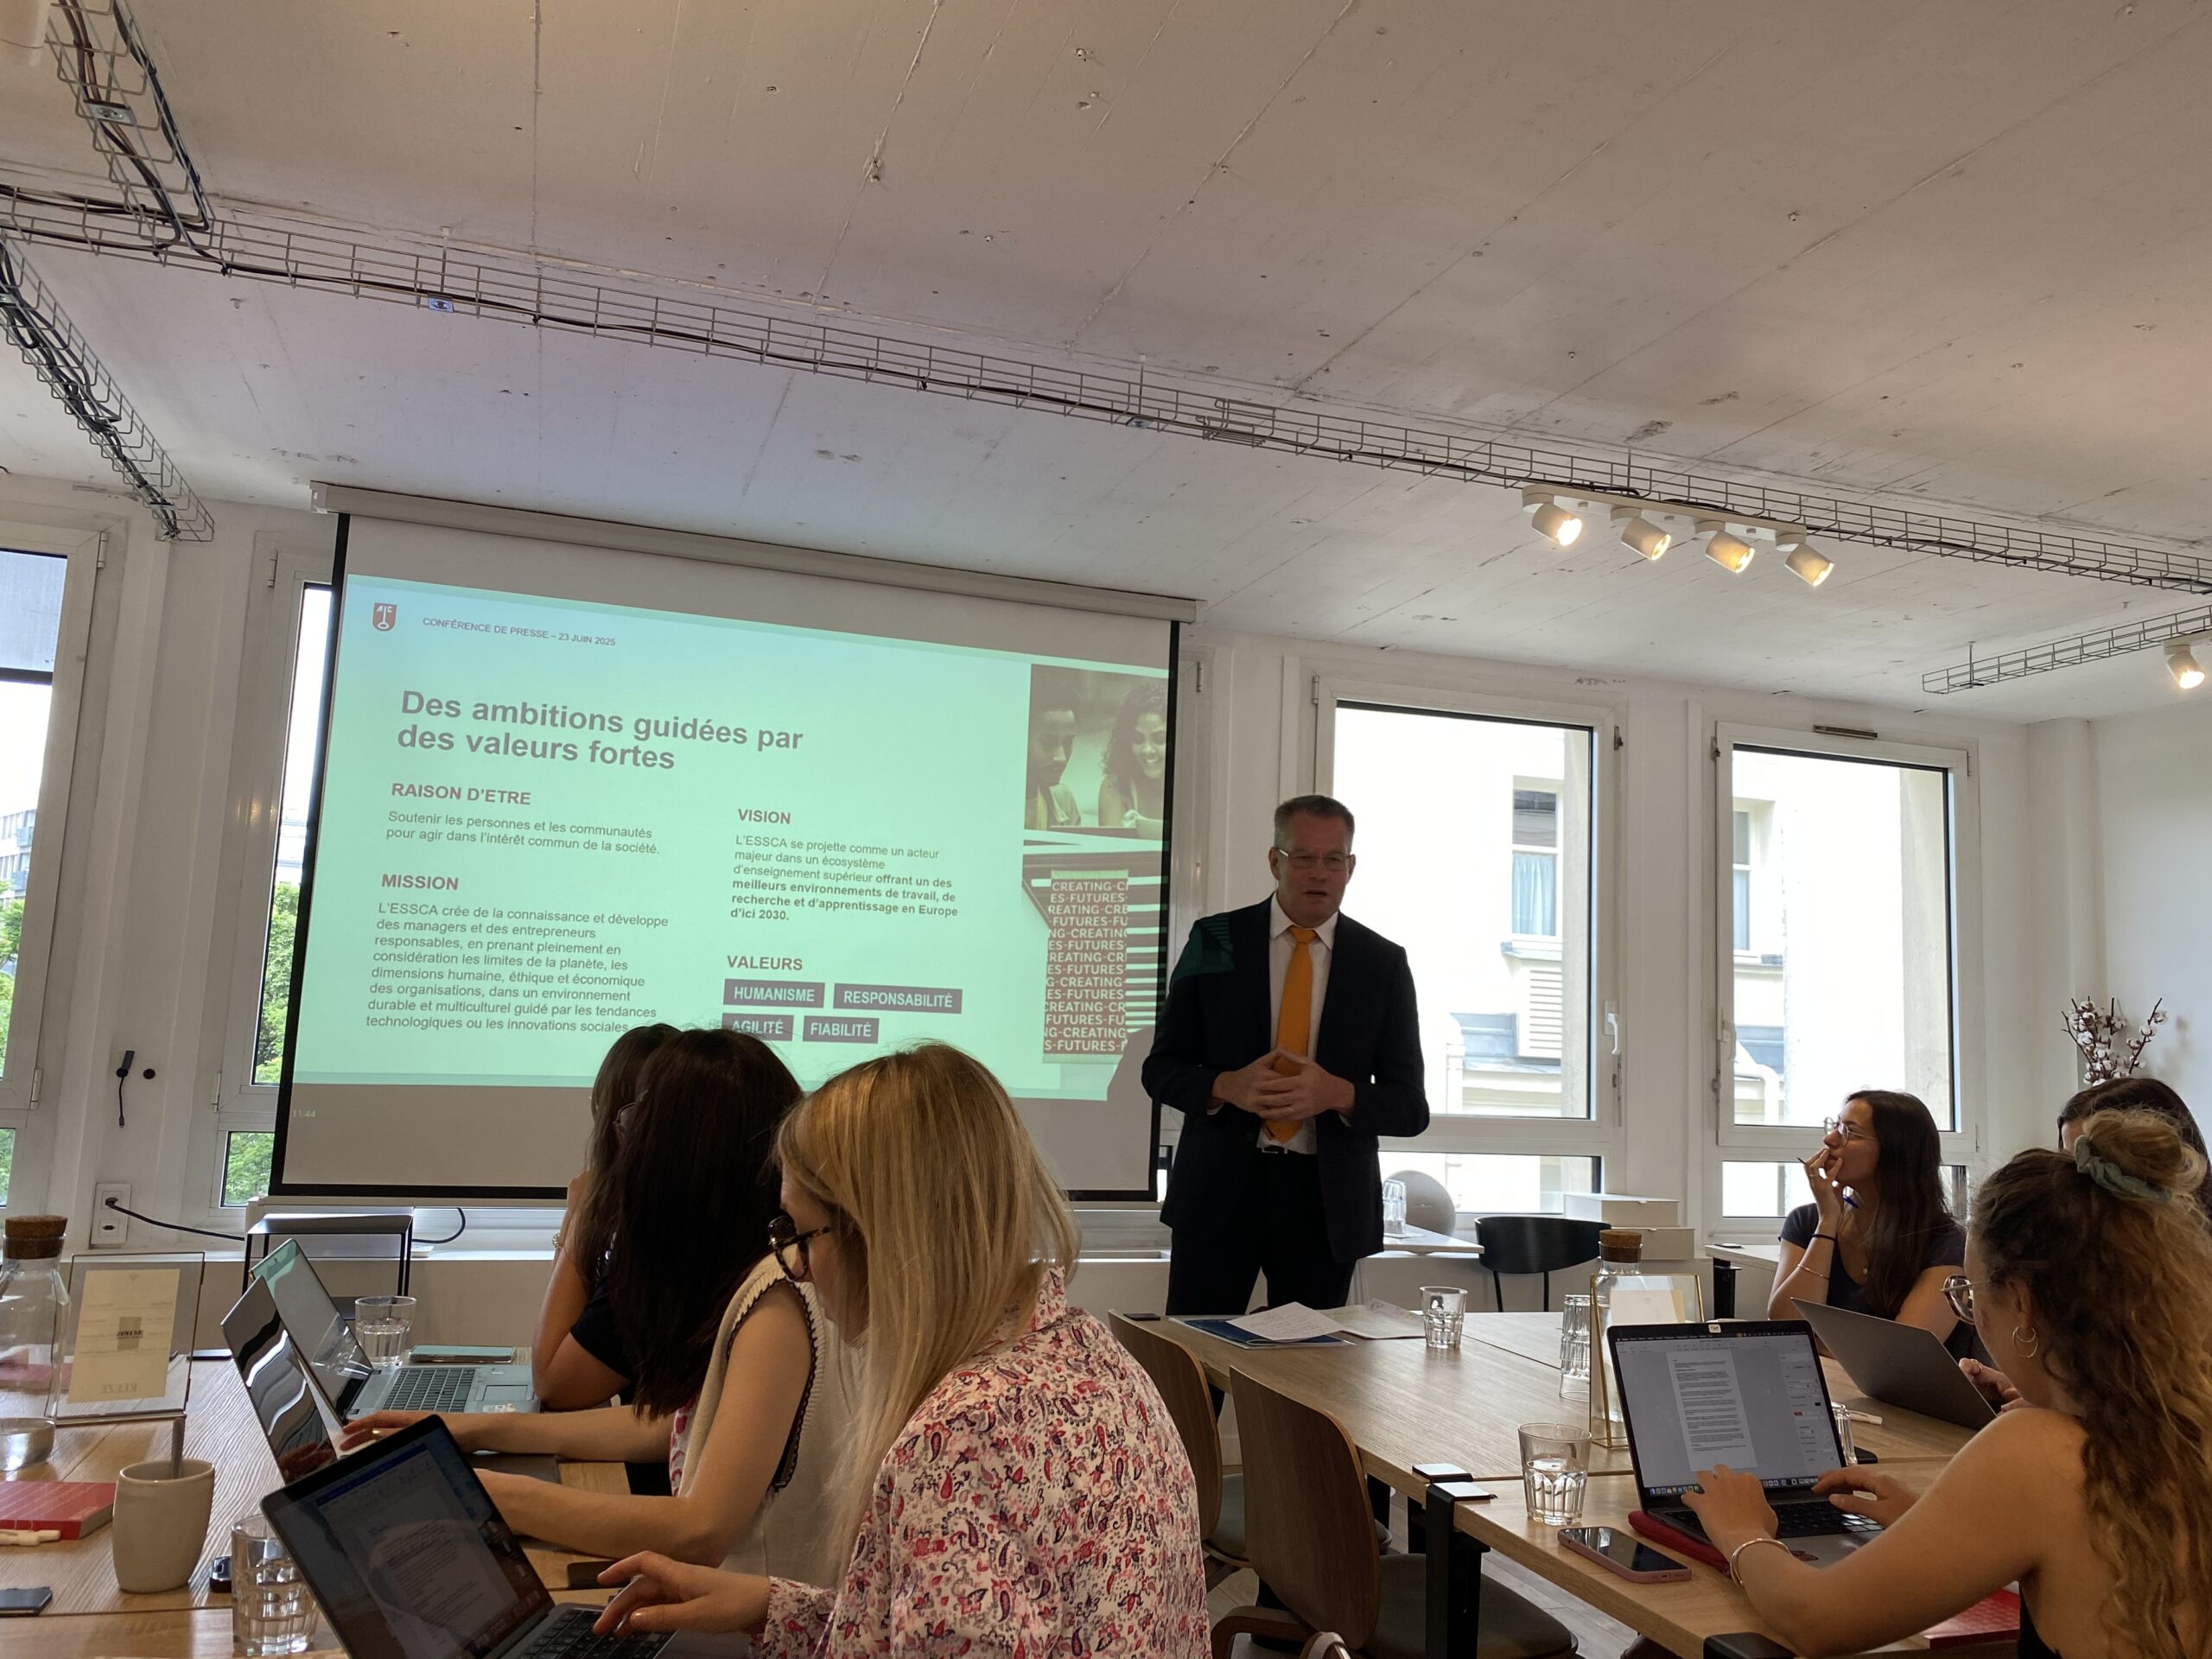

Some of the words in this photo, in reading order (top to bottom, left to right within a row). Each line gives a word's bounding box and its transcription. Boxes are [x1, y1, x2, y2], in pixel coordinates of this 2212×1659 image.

[423, 618, 492, 632] CONFÉRENCE
[493, 625, 507, 634] DE
[510, 626, 549, 639] PRESSE
[558, 632, 569, 641] 23
[570, 634, 593, 644] JUIN
[594, 637, 616, 646] 2025
[402, 690, 461, 718] Des
[472, 702, 623, 733] ambitions
[633, 716, 747, 745] guidées
[758, 729, 804, 750] par
[397, 724, 454, 751] des
[466, 732, 578, 761] valeurs
[588, 740, 675, 769] fortes
[391, 783, 461, 800] RAISON
[388, 810, 442, 824] Soutenir
[445, 814, 463, 826] les
[467, 817, 531, 830] personnes
[534, 821, 545, 831] et
[549, 822, 566, 833] les
[569, 825, 652, 839] communautés
[738, 809, 791, 824] VISION
[386, 829, 416, 840] pour
[418, 829, 443, 842] agir
[446, 830, 477, 842] dans
[528, 837, 580, 849] commun
[582, 839, 598, 850] de
[601, 840, 612, 851] la
[615, 842, 660, 855] société.
[791, 841, 804, 849] se
[806, 841, 847, 854] projette
[849, 845, 888, 855] comme
[891, 848, 904, 856] un
[906, 849, 939, 859] acteur
[734, 850, 773, 863] majeur
[775, 852, 803, 864] dans
[805, 856, 819, 865] un
[822, 855, 885, 870] écosystème
[381, 874, 459, 891] MISSION
[823, 871, 874, 883] supérieur
[875, 874, 912, 886] offrant
[915, 878, 930, 887] un
[932, 878, 952, 888] des
[733, 880, 786, 891] meilleurs
[790, 883, 882, 897] environnements
[885, 888, 899, 899] de
[902, 890, 939, 903] travail,
[942, 892, 956, 902] de
[732, 894, 791, 906] recherche
[793, 897, 805, 907] et
[918, 905, 957, 918] Europe
[759, 909, 789, 920] 2030.
[442, 906, 470, 917] crée
[473, 906, 489, 918] de
[493, 907, 504, 918] la
[506, 910, 590, 923] connaissance
[593, 913, 605, 924] et
[607, 913, 669, 929] développe
[377, 918, 400, 930] des
[404, 922, 467, 935] managers
[470, 923, 482, 933] et
[486, 923, 508, 935] des
[512, 925, 596, 939] entrepreneurs
[375, 937, 463, 950] responsables,
[467, 940, 483, 950] en
[486, 941, 534, 952] prenant
[537, 941, 603, 955] pleinement
[606, 946, 621, 955] en
[373, 951, 458, 964] considération
[462, 953, 480, 965] les
[484, 954, 523, 966] limites
[526, 956, 543, 967] de
[545, 957, 556, 968] la
[559, 957, 607, 971] planète,
[611, 960, 628, 970] les
[727, 955, 803, 971] VALEURS
[1049, 952, 1127, 963] REATING-CR
[372, 966, 444, 980] dimensions
[448, 969, 505, 983] humaine,
[509, 971, 554, 986] éthique
[557, 973, 569, 984] et
[572, 973, 645, 989] économique
[370, 982, 393, 994] des
[397, 984, 485, 998] organisations,
[488, 986, 519, 998] dans
[523, 989, 538, 998] un
[541, 988, 631, 1001] environnement
[734, 986, 815, 1002] HUMANISME
[843, 990, 953, 1007] RESPONSABILITÉ
[367, 999, 416, 1011] durable
[420, 1001, 432, 1011] et
[435, 1001, 511, 1014] multiculturel
[514, 1003, 548, 1016] guidé
[551, 1006, 572, 1017] par
[575, 1004, 592, 1016] les
[595, 1006, 657, 1018] tendances
[366, 1015, 463, 1030] technologiques
[466, 1020, 482, 1029] ou
[486, 1018, 504, 1029] les
[507, 1019, 576, 1031] innovations
[732, 1019, 784, 1034] AGILITÉ
[810, 1021, 872, 1037] FIABILITÉ
